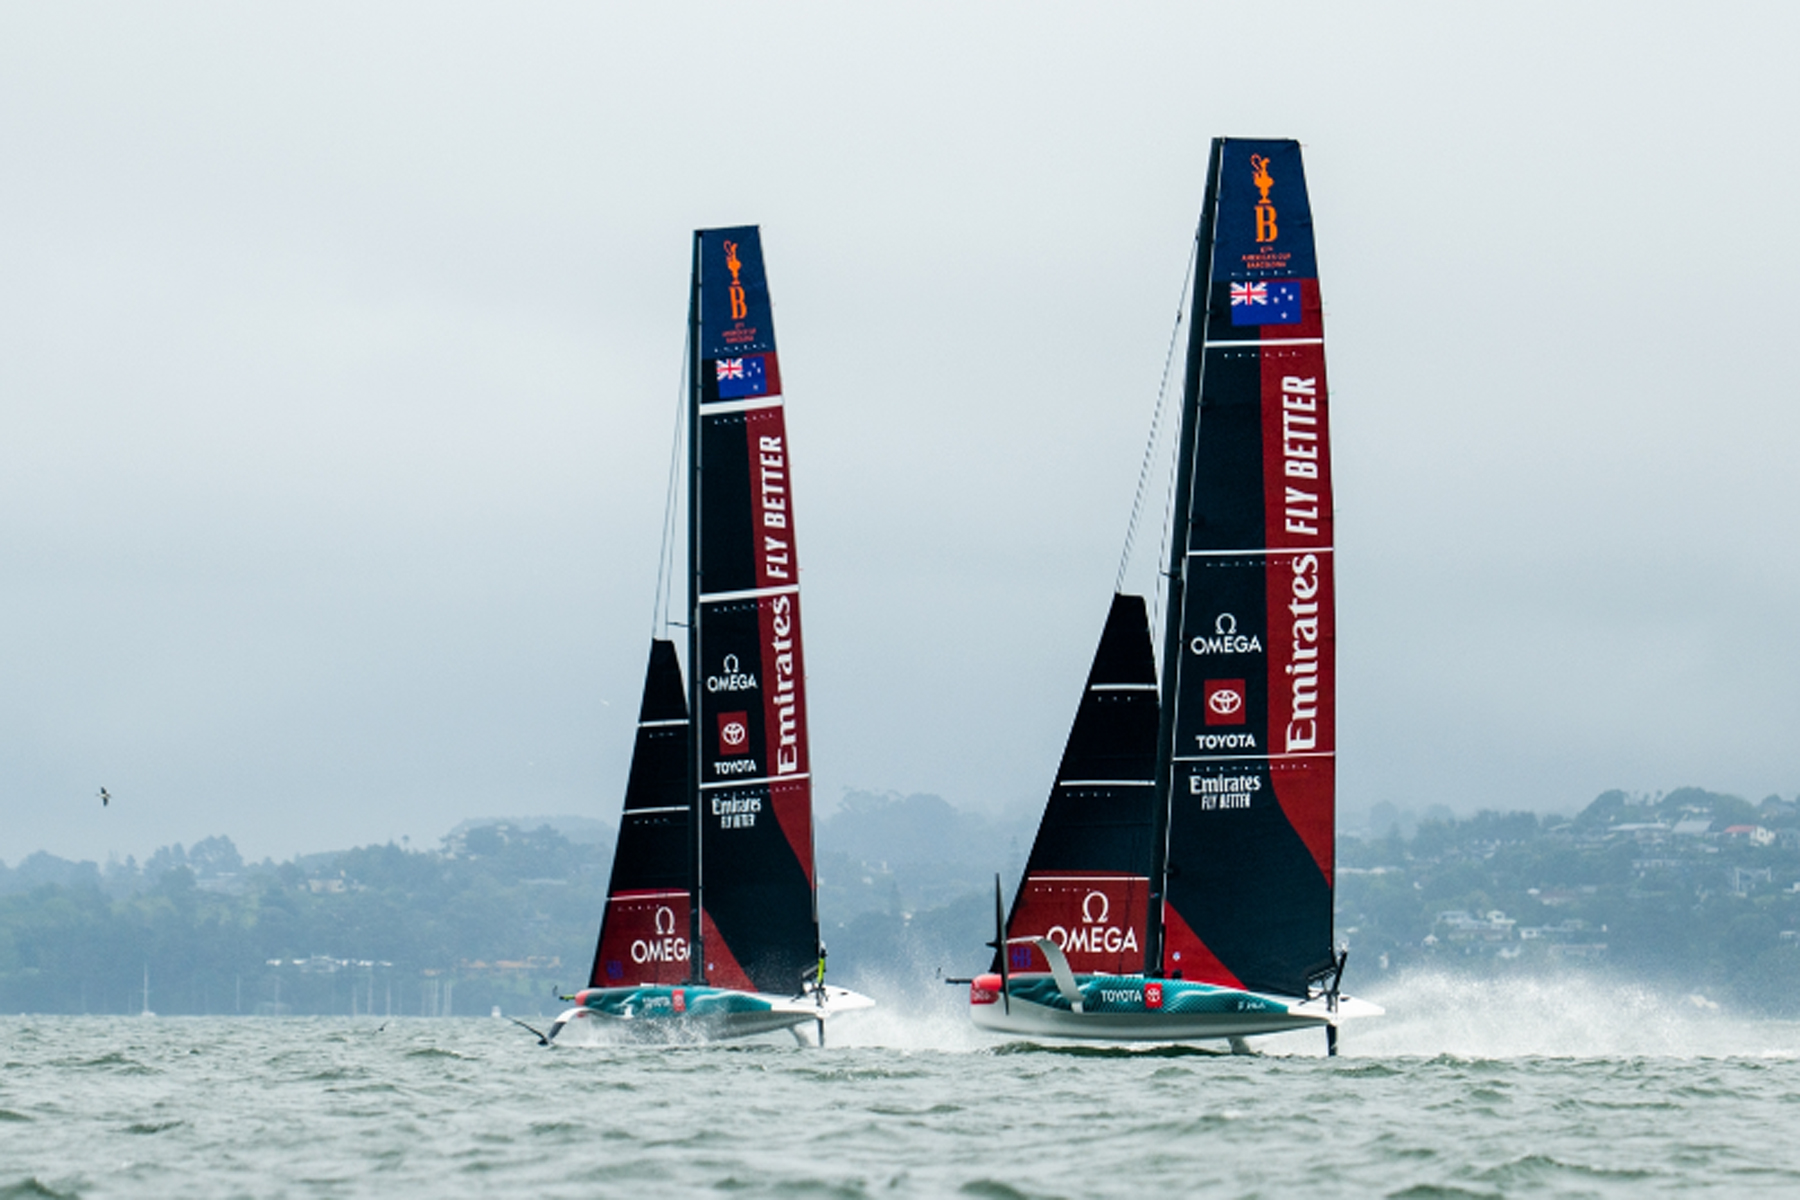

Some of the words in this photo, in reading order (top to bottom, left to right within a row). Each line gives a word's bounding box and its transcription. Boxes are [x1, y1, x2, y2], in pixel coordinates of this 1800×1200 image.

[1254, 204, 1278, 242] B
[729, 285, 747, 320] B
[1282, 376, 1318, 479] BETTER
[759, 436, 786, 528] BETTER
[1285, 486, 1319, 535] FLY
[764, 536, 789, 578] FLY
[1191, 635, 1262, 655] OMEGA
[1285, 553, 1318, 753] Emirates
[707, 674, 758, 692] OMEGA
[771, 595, 798, 774] Emirates
[1196, 734, 1256, 750] TOYOTA
[714, 759, 756, 775] TOYOTA
[1189, 774, 1261, 795] Emirates
[1047, 925, 1138, 953] OMEGA
[1101, 989, 1142, 1002] TOYOTA
